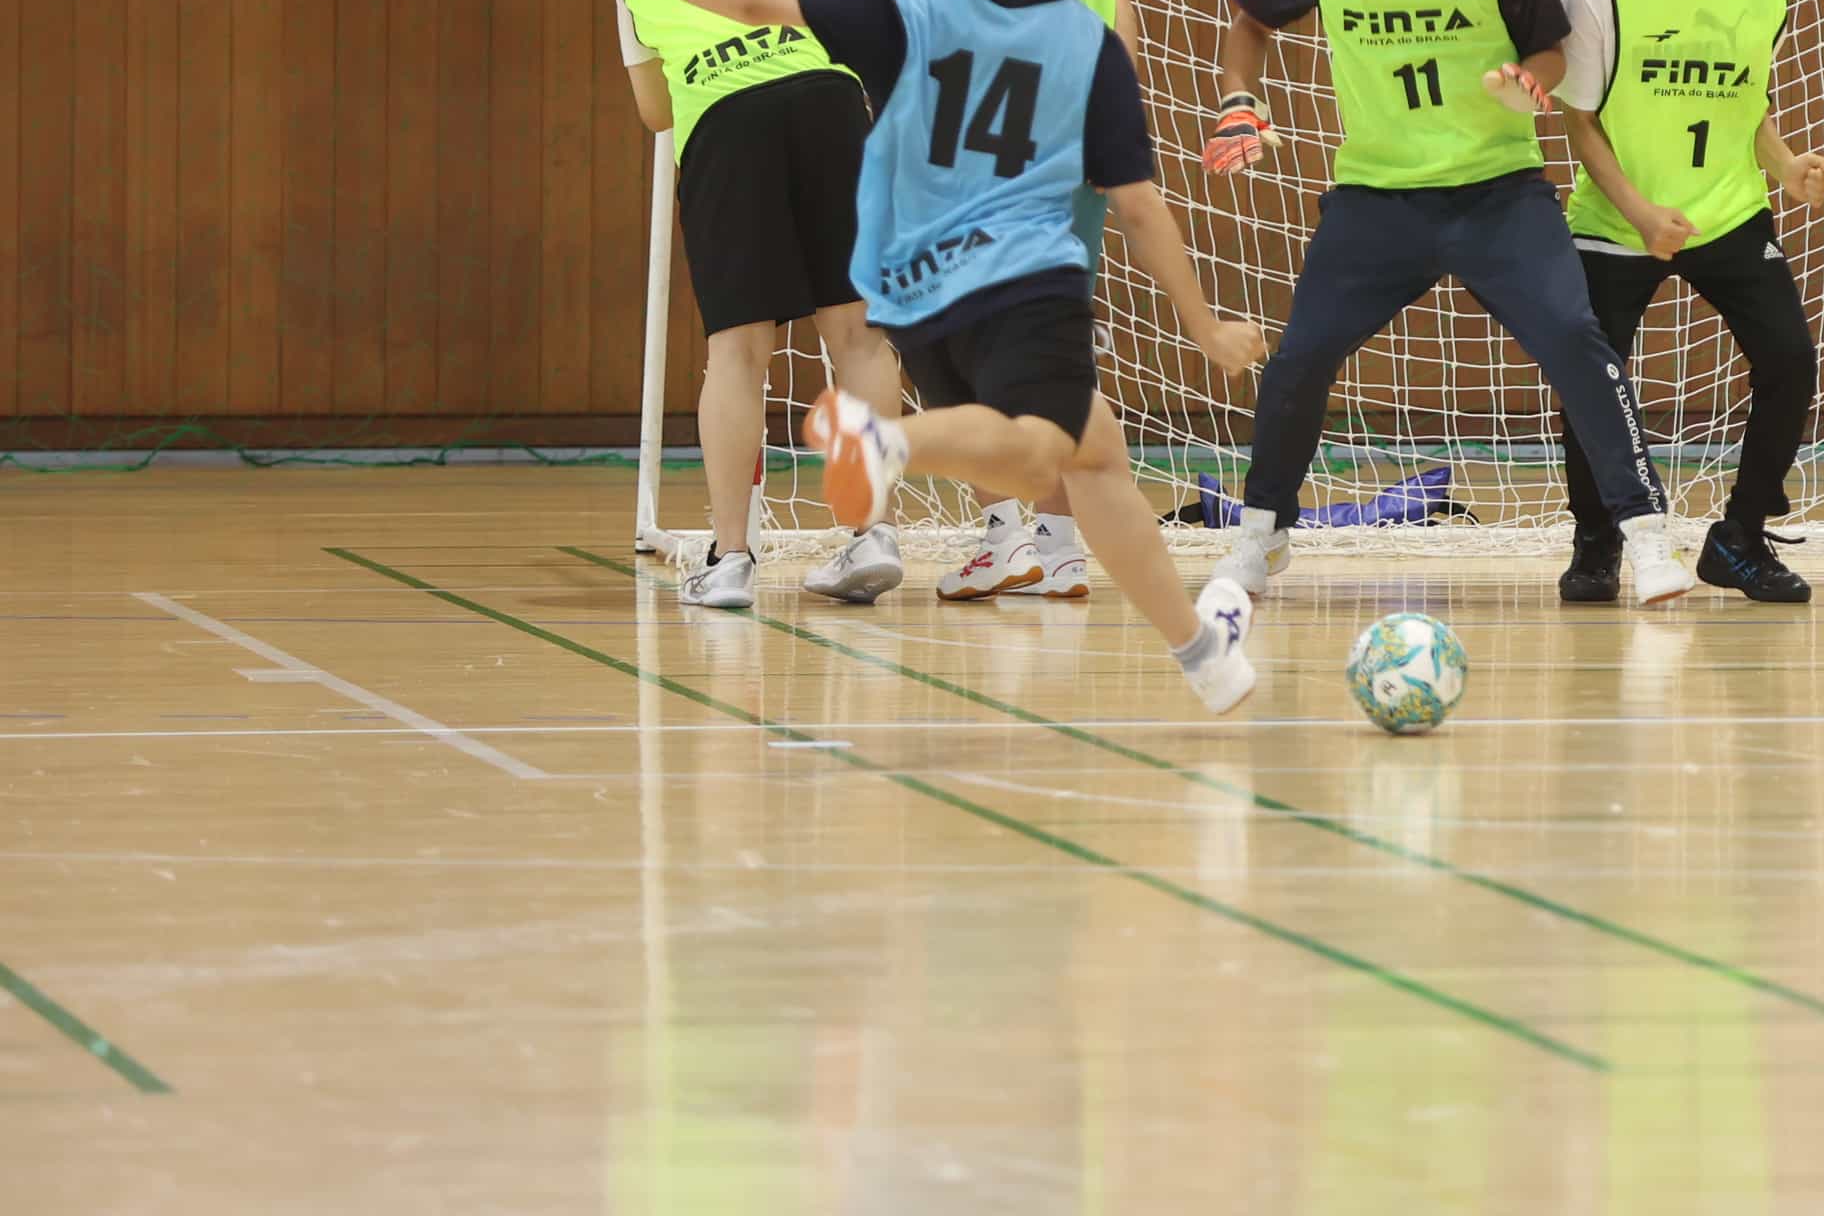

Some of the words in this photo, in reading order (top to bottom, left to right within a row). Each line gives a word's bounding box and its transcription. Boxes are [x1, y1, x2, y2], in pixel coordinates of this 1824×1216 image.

[1393, 58, 1443, 110] 11
[1654, 88, 1686, 97] FINTA
[928, 49, 1042, 179] 14
[1687, 120, 1710, 168] 1
[1616, 384, 1644, 454] PRODUCTS
